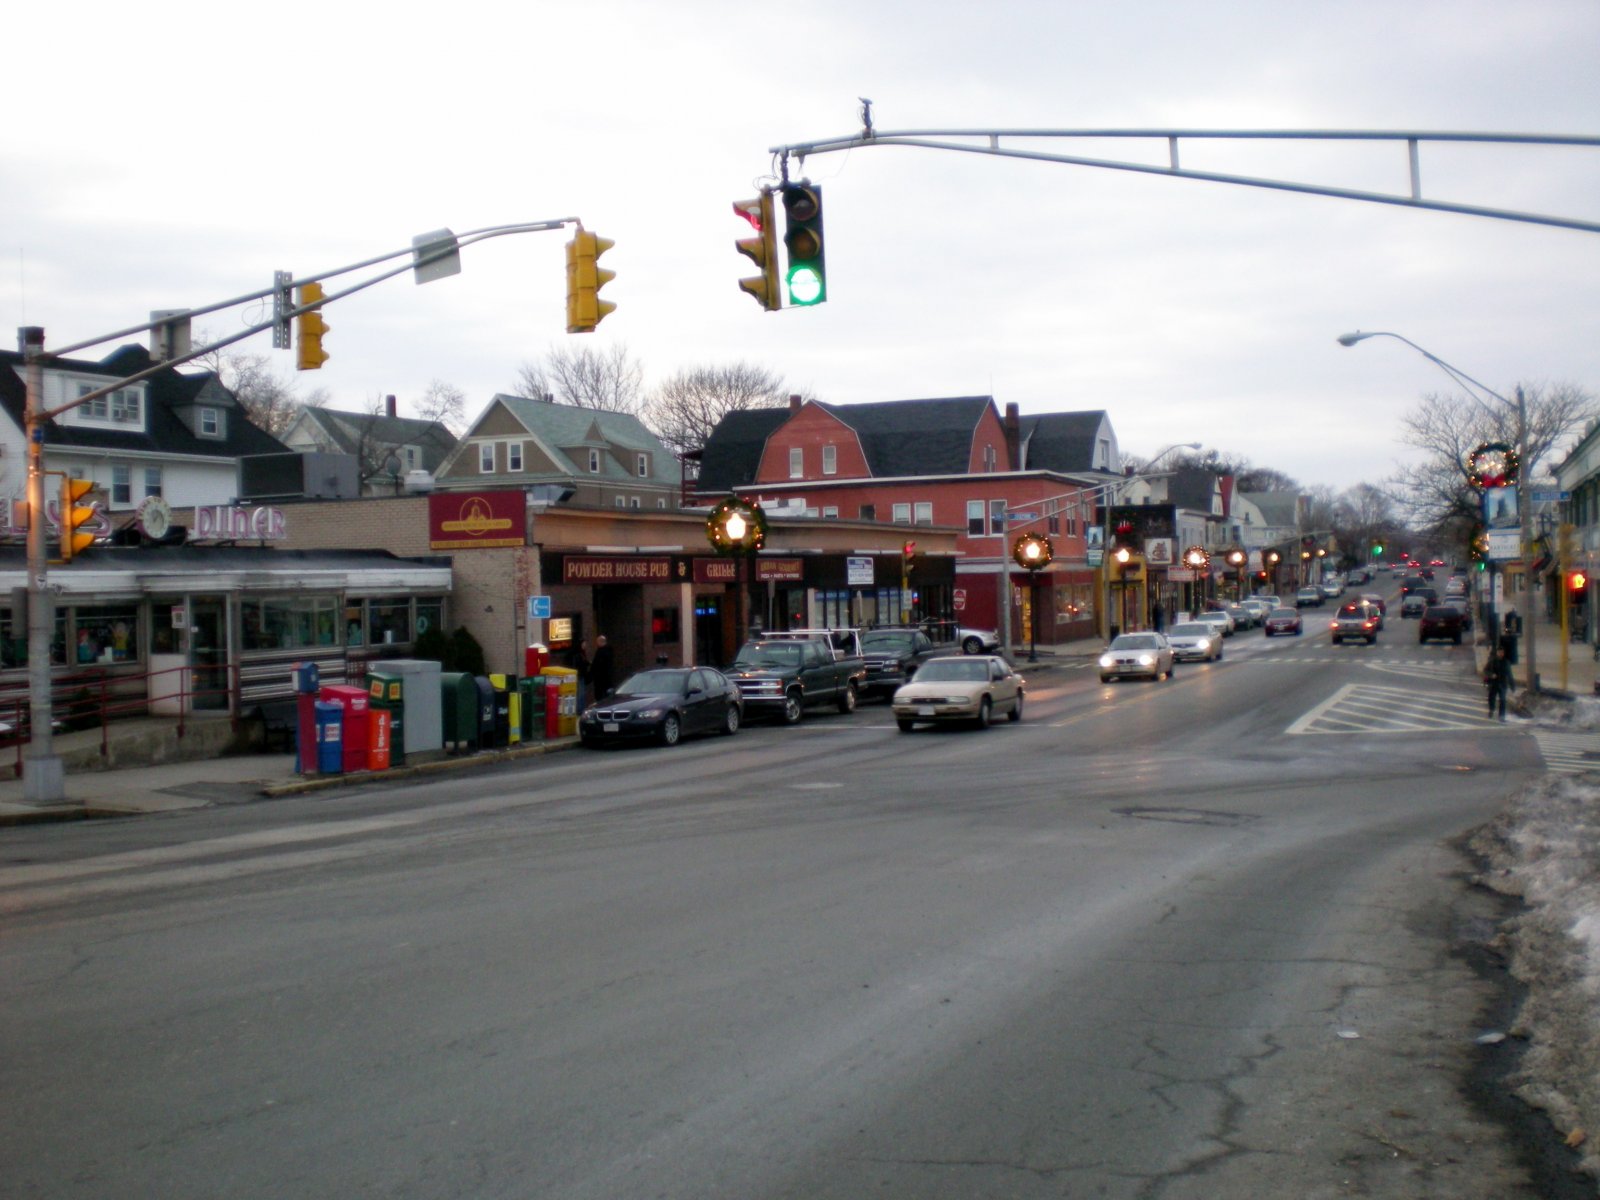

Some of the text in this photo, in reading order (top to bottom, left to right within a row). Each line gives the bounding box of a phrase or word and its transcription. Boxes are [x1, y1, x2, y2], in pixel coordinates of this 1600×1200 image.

[194, 506, 287, 539] DINER
[567, 561, 736, 578] POWDER HOUSE PUB & GRILLE
